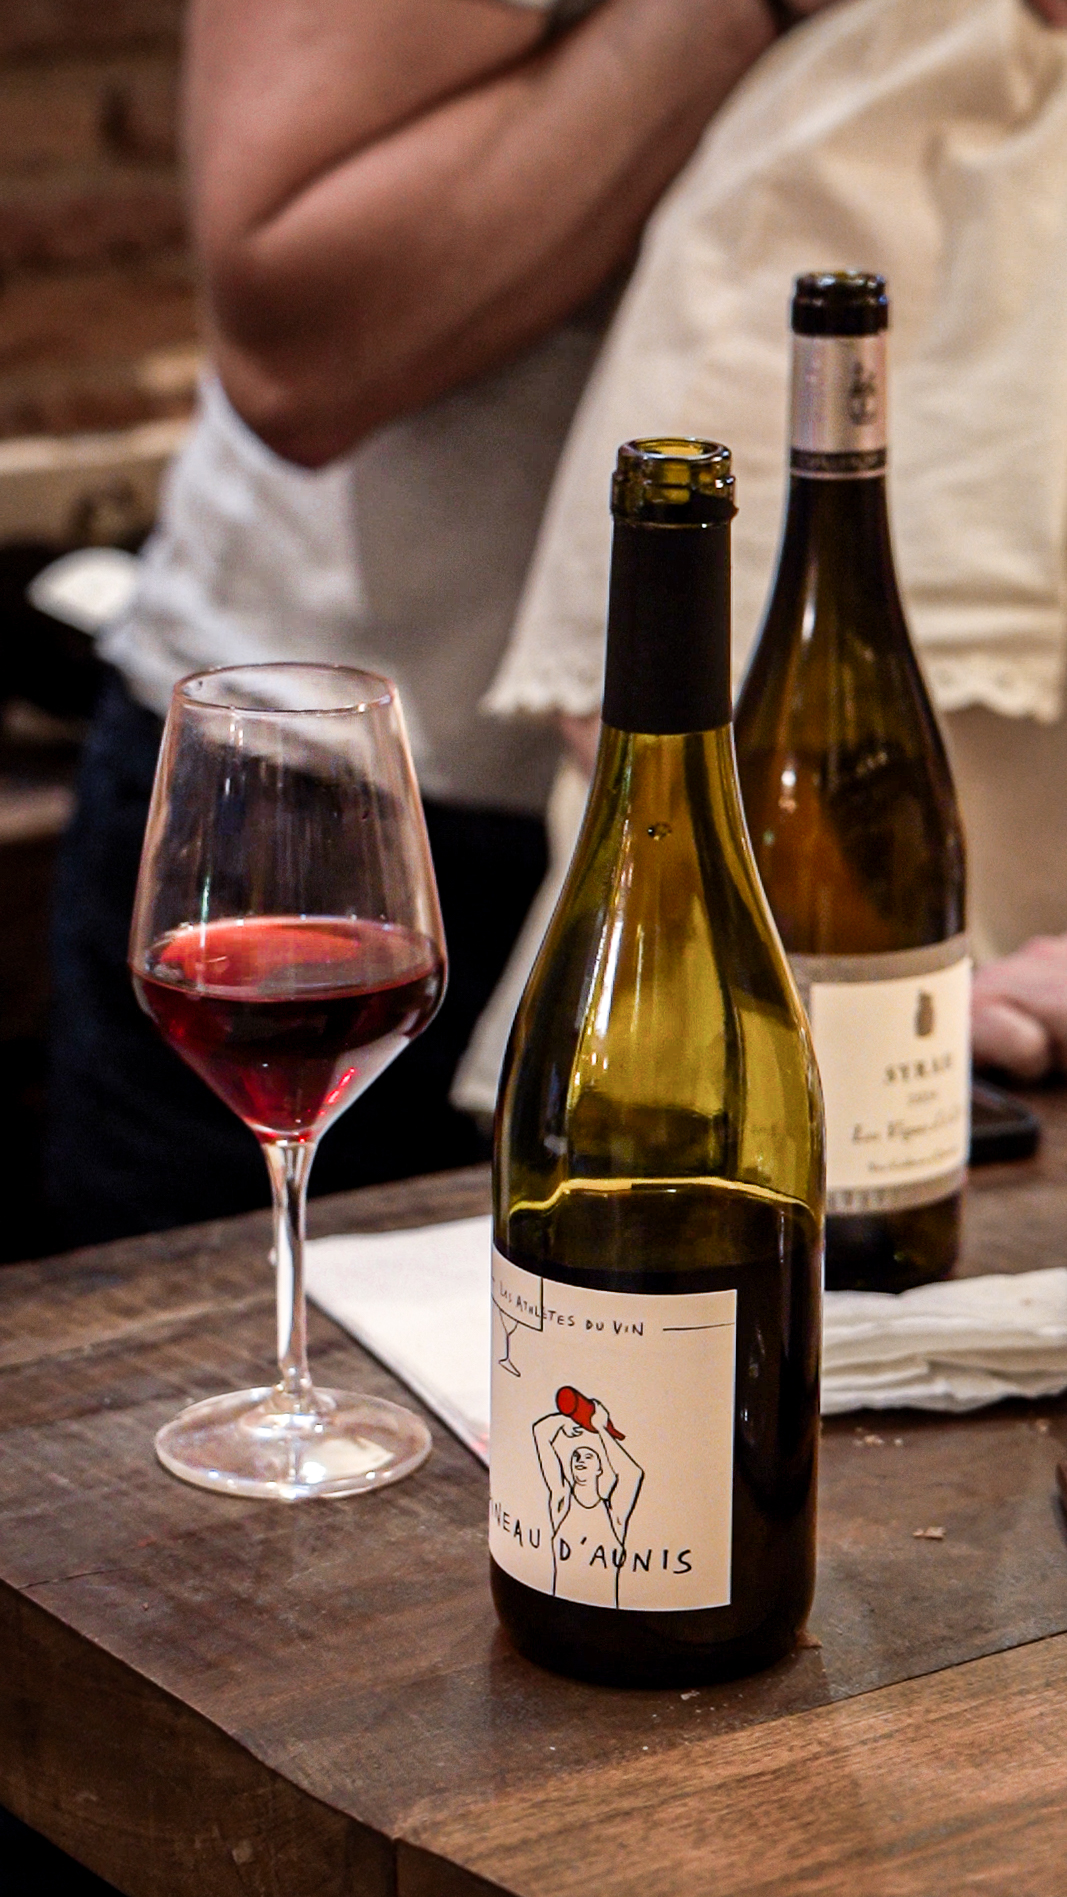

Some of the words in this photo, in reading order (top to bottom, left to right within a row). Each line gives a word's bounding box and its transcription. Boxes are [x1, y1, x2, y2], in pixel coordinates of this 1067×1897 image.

[586, 1319, 605, 1332] DU
[613, 1321, 644, 1337] VIN
[559, 1536, 693, 1574] D'AUNIS
